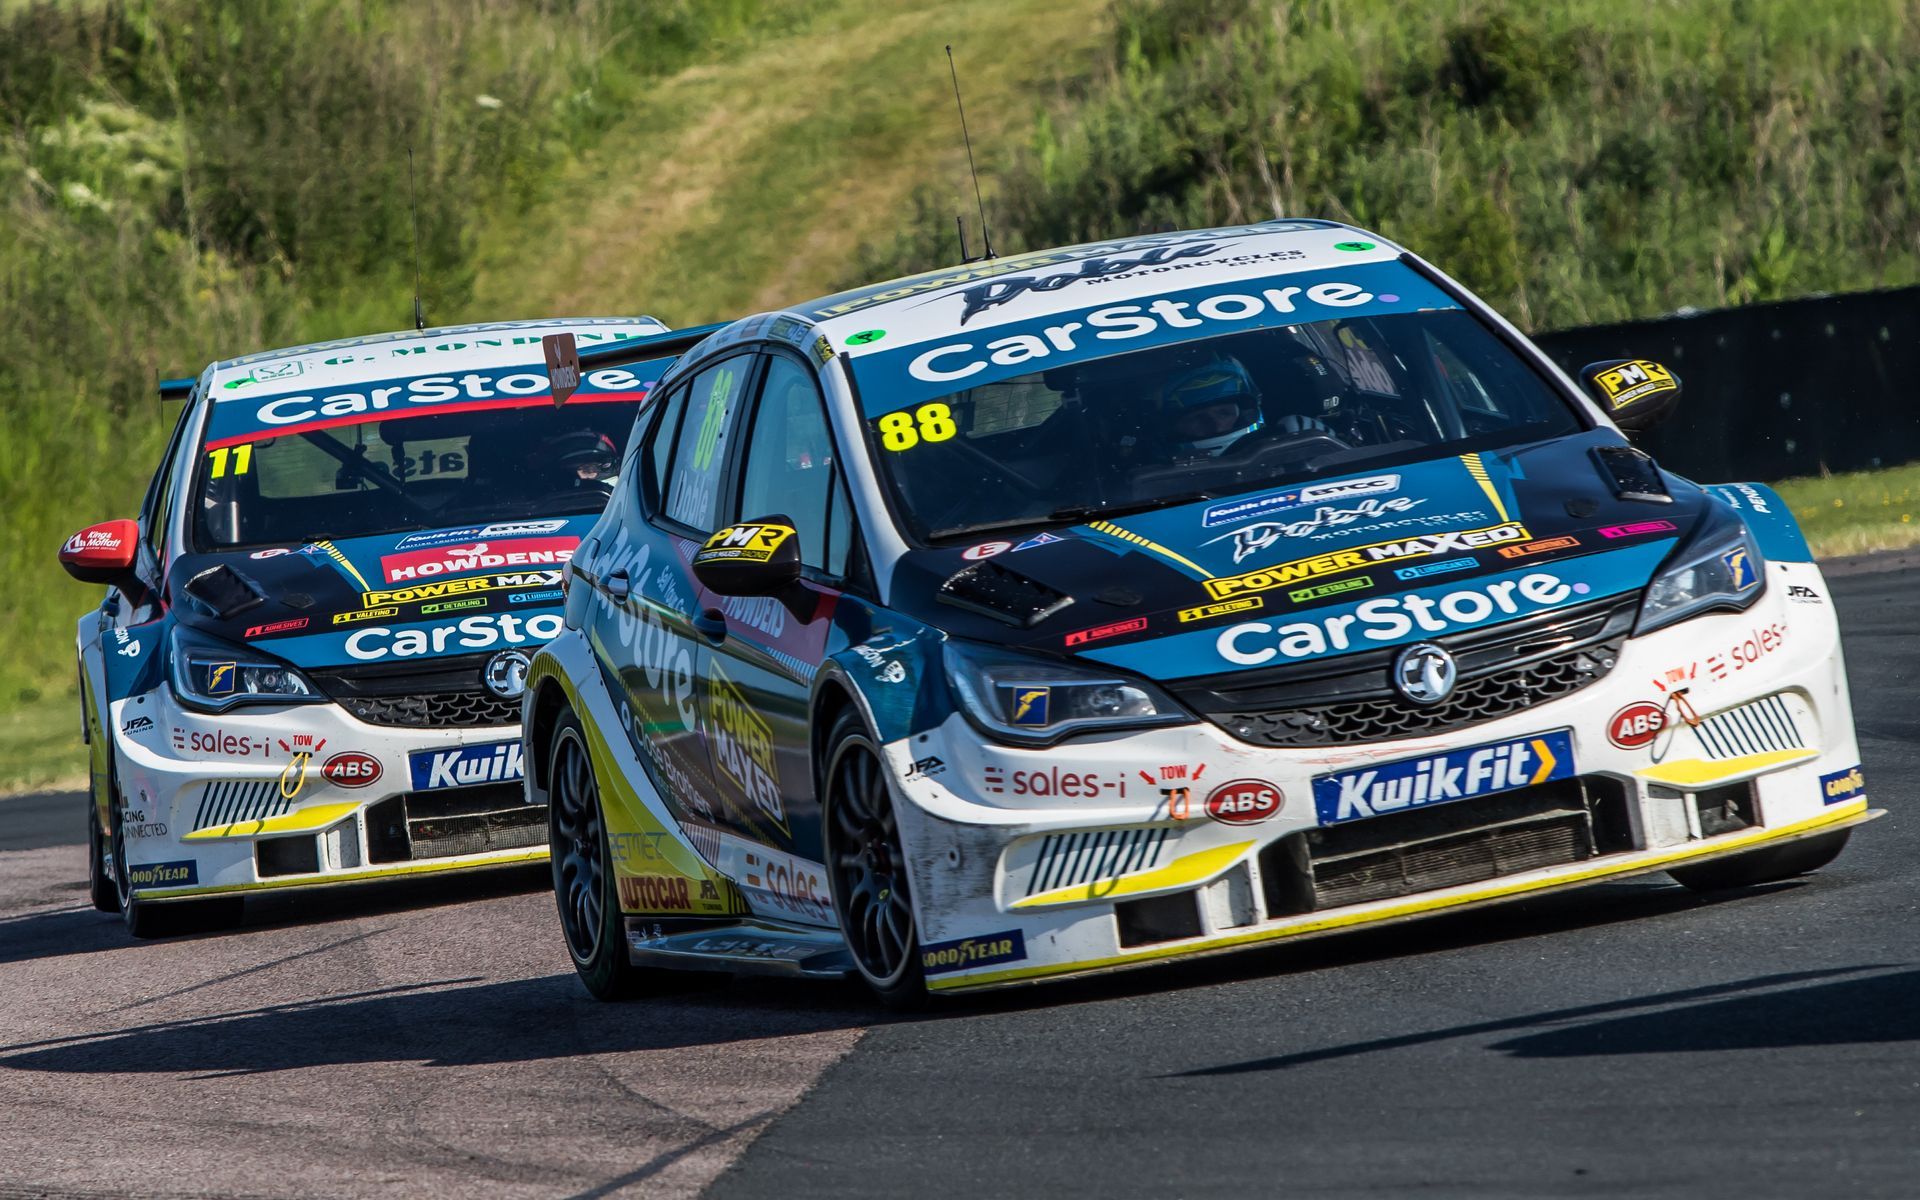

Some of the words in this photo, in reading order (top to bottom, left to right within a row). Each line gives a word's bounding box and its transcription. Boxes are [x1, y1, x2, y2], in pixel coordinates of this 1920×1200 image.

[1086, 249, 1303, 285] MOTORCYCLES
[878, 403, 957, 452] 88
[208, 443, 253, 479] 11
[1309, 480, 1388, 497] BTCC
[705, 527, 784, 549] PMR
[391, 550, 575, 582] HOWDENS
[1213, 543, 1368, 597] POWER
[1366, 525, 1521, 561] MAXED
[370, 578, 491, 606] POWER
[1786, 585, 1820, 598] JFA
[122, 716, 154, 732] JFA
[712, 673, 777, 784] POWER
[1616, 711, 1664, 739] ABS
[190, 729, 270, 757] sales-i
[293, 735, 313, 746] TOW
[331, 761, 374, 777] ABS
[904, 755, 945, 777] JFA
[1160, 764, 1188, 781] TOW
[1012, 765, 1127, 799] sales-i
[1216, 789, 1274, 814] ABS
[620, 876, 692, 910] AUTOCAR
